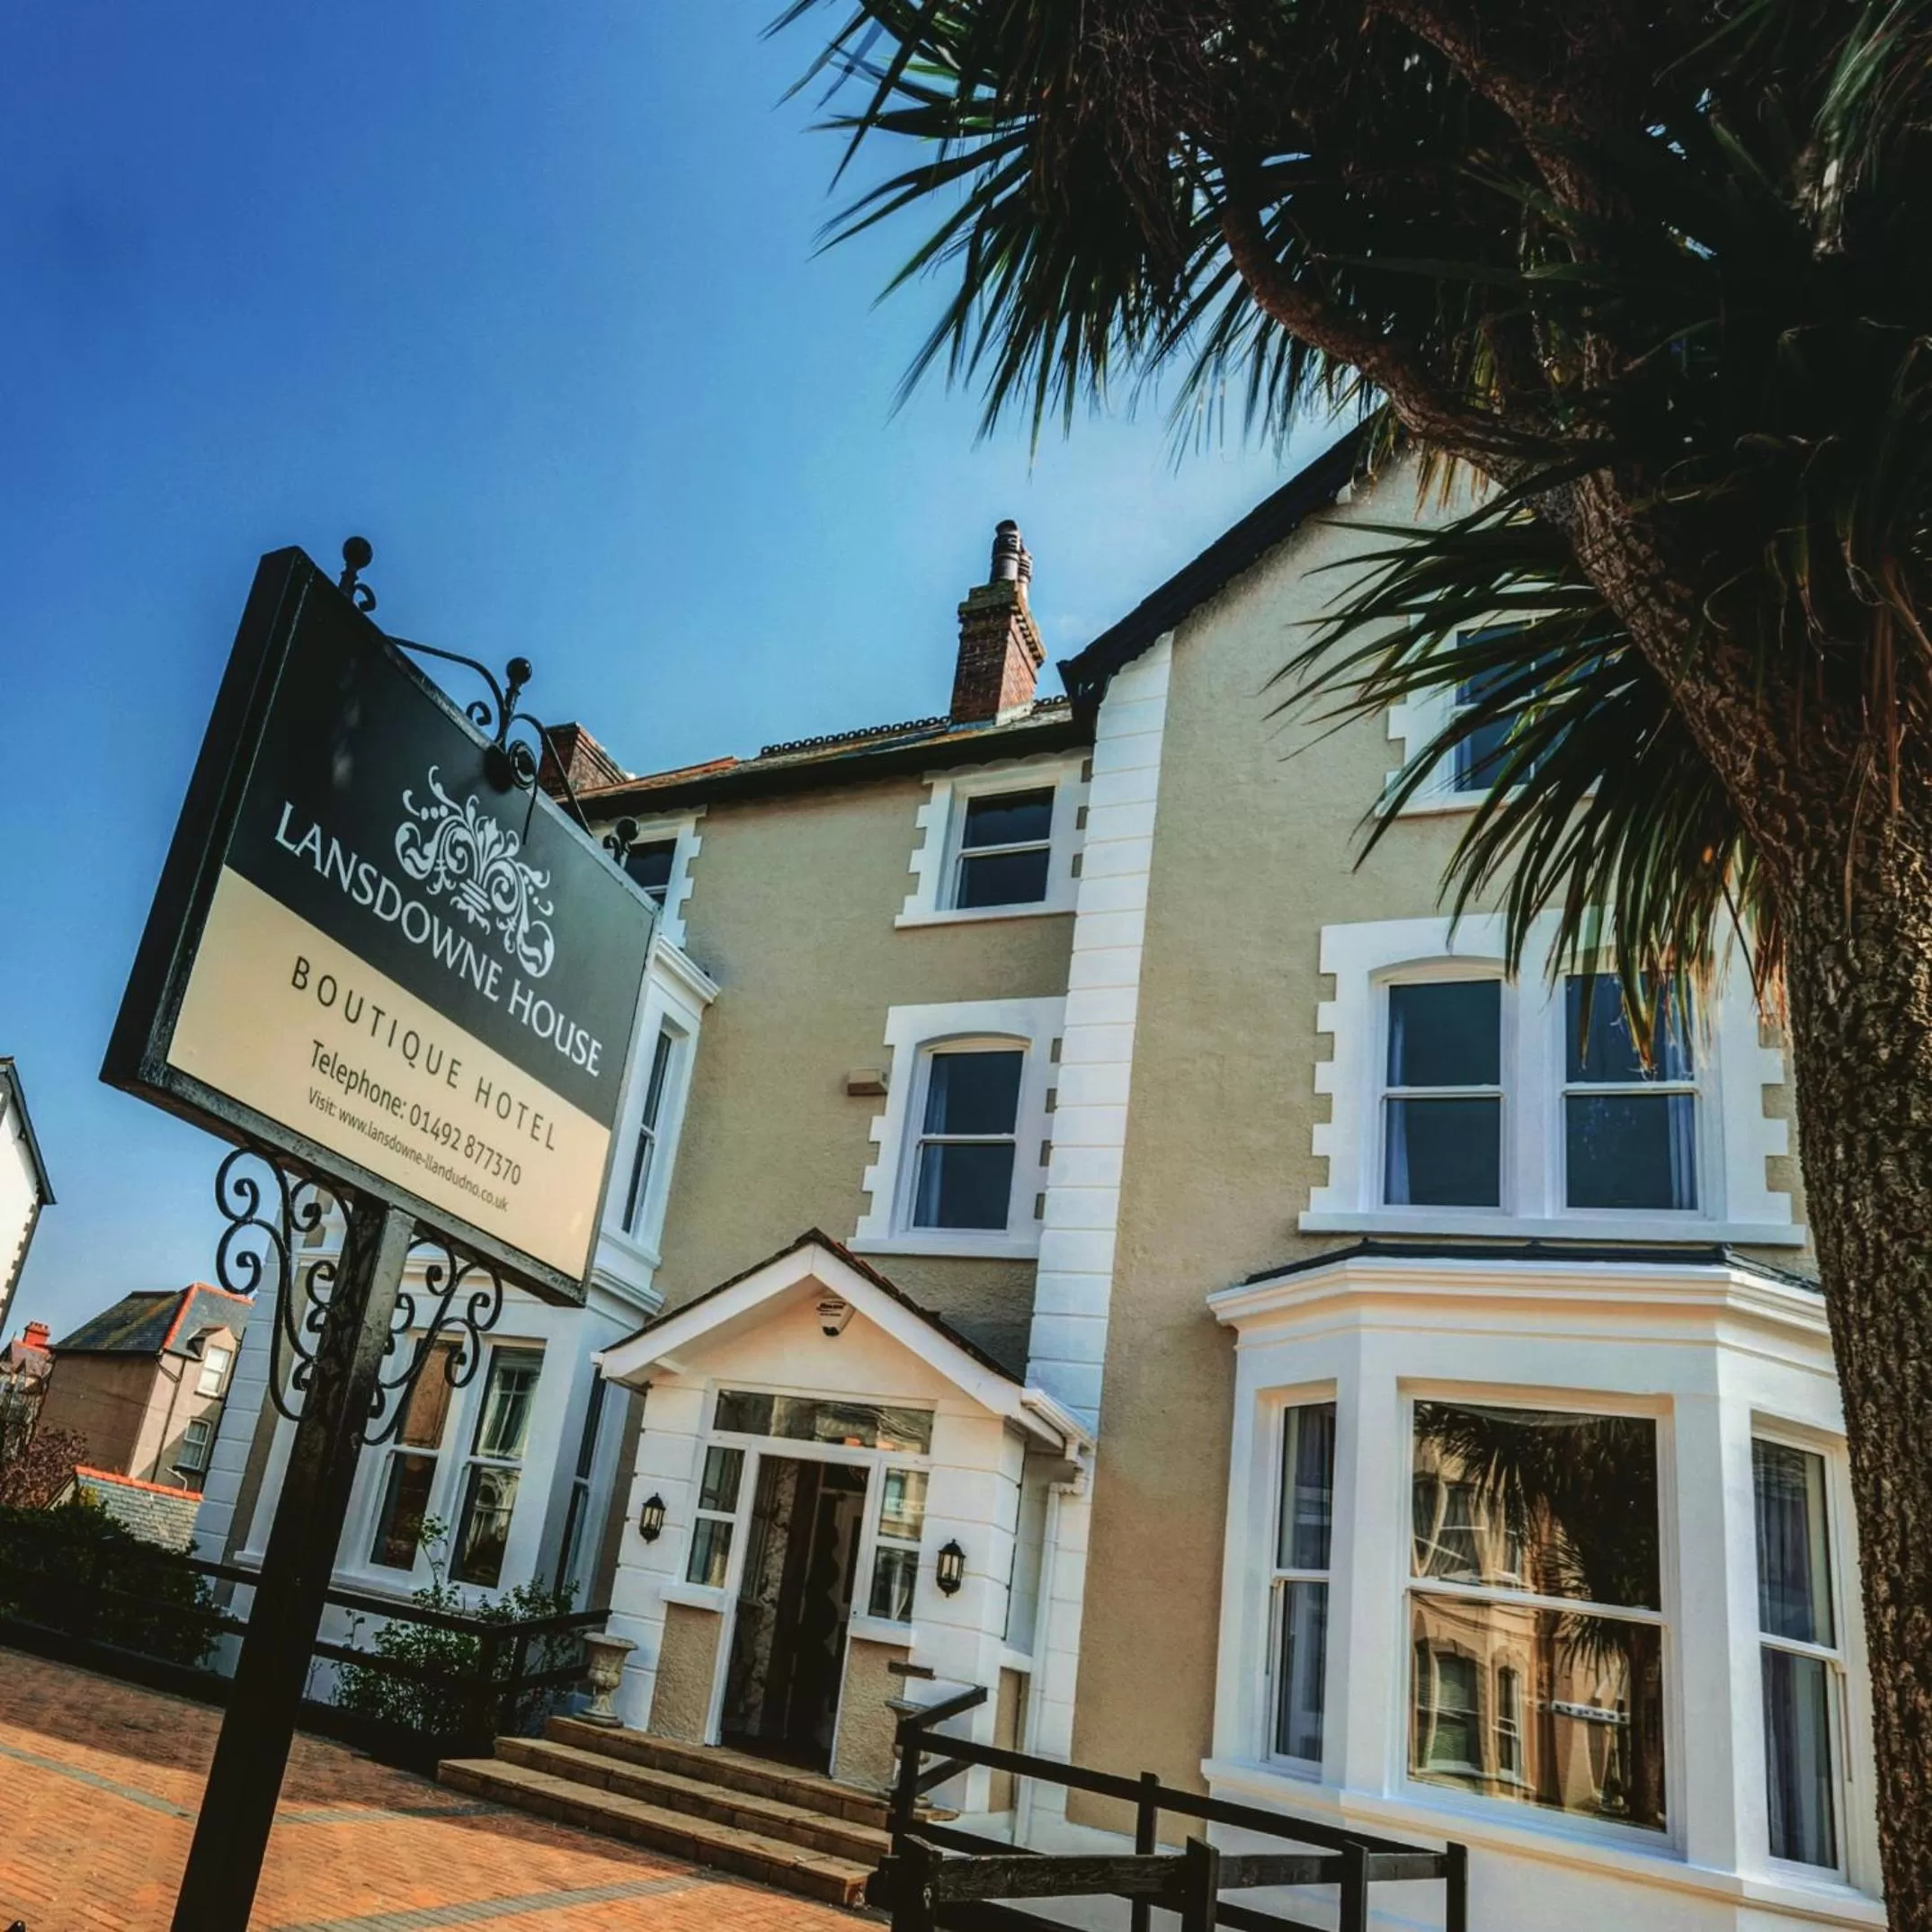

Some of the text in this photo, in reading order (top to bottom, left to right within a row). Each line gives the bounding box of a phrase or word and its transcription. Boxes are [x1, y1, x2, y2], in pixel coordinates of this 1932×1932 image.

[274, 801, 603, 1077] LANSDOWNE HOUSE
[290, 956, 556, 1151] BOUTIQUE HOTEL
[311, 1039, 521, 1186] Telephone: 01492 877370
[308, 1086, 509, 1212] Visit: www.lansdowne-llandudno.co.uk
